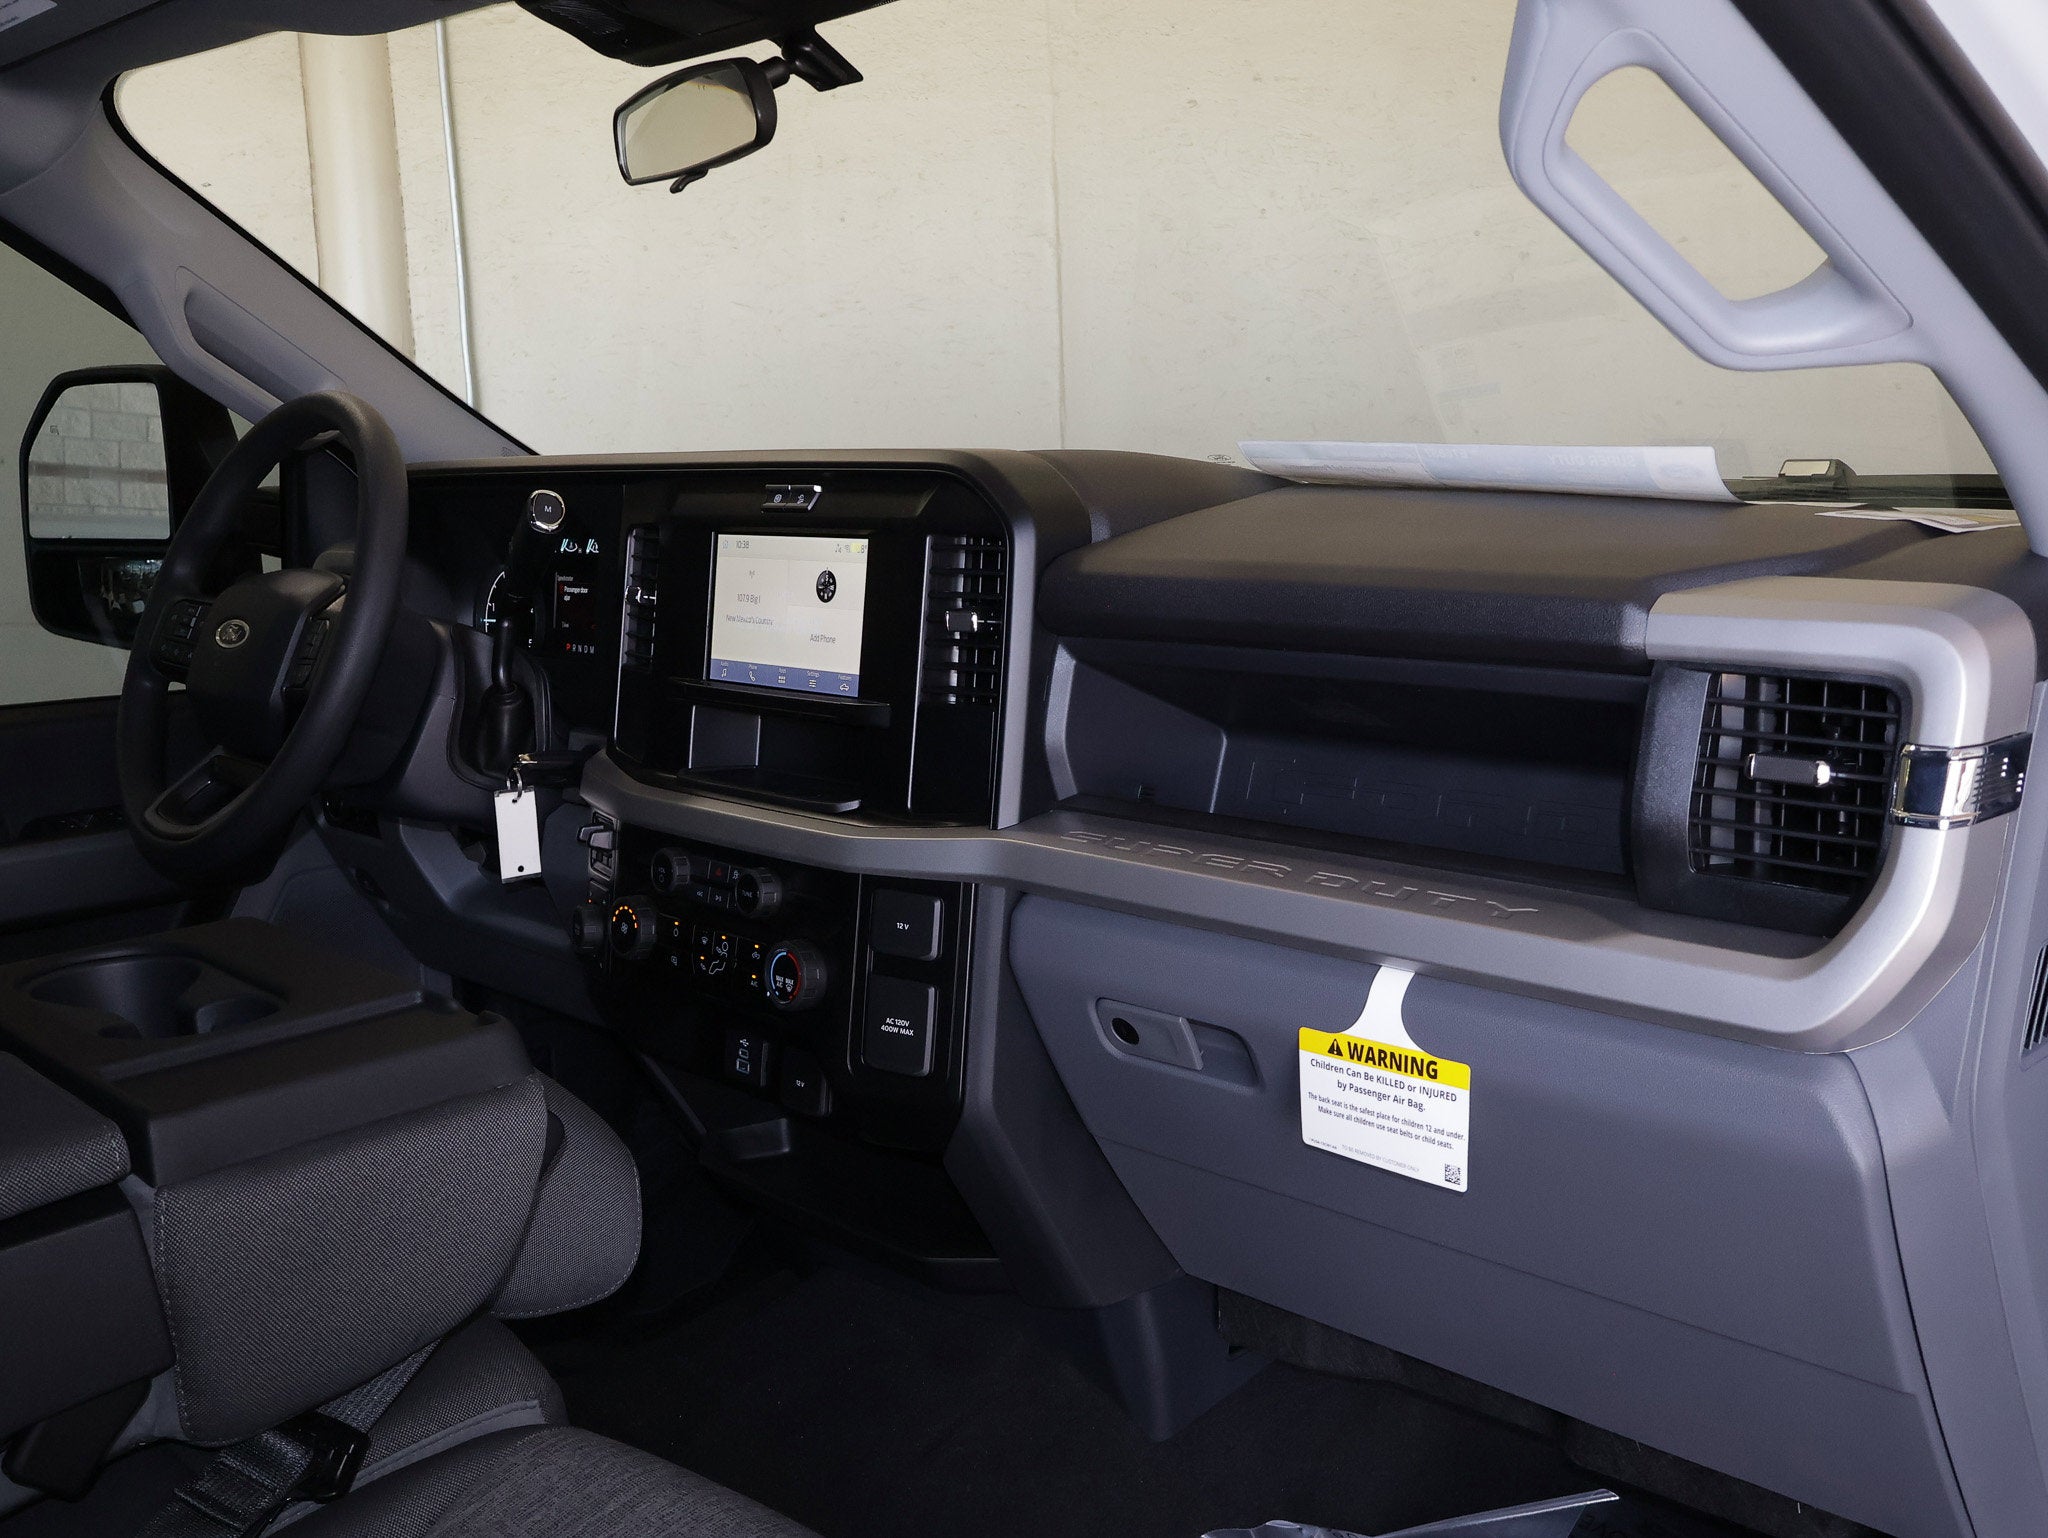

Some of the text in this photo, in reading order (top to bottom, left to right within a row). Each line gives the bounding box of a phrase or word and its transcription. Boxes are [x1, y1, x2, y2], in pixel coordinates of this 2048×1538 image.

[809, 634, 836, 644] Add Phone
[1060, 831, 1540, 919] SUPER DUTY
[880, 1024, 914, 1036] 400W MAX
[885, 1017, 910, 1028] AC 120V
[1310, 1058, 1457, 1102] Children Can Be KILLED or INJURED
[1347, 1041, 1438, 1080] WARNING
[1337, 1079, 1426, 1113] by Passenger Air Bag.
[1308, 1091, 1318, 1101] The
[1318, 1095, 1330, 1105] back
[1331, 1099, 1343, 1109] seat
[1349, 1103, 1359, 1113] the
[1359, 1107, 1375, 1117] safest
[1376, 1111, 1391, 1121] place
[1391, 1114, 1400, 1123] for
[1401, 1118, 1424, 1130] children
[1425, 1124, 1432, 1133] 12
[1433, 1127, 1445, 1136] and
[1446, 1131, 1466, 1142] under.
[1318, 1105, 1455, 1150] Make sure all children use seat belts or child seats.
